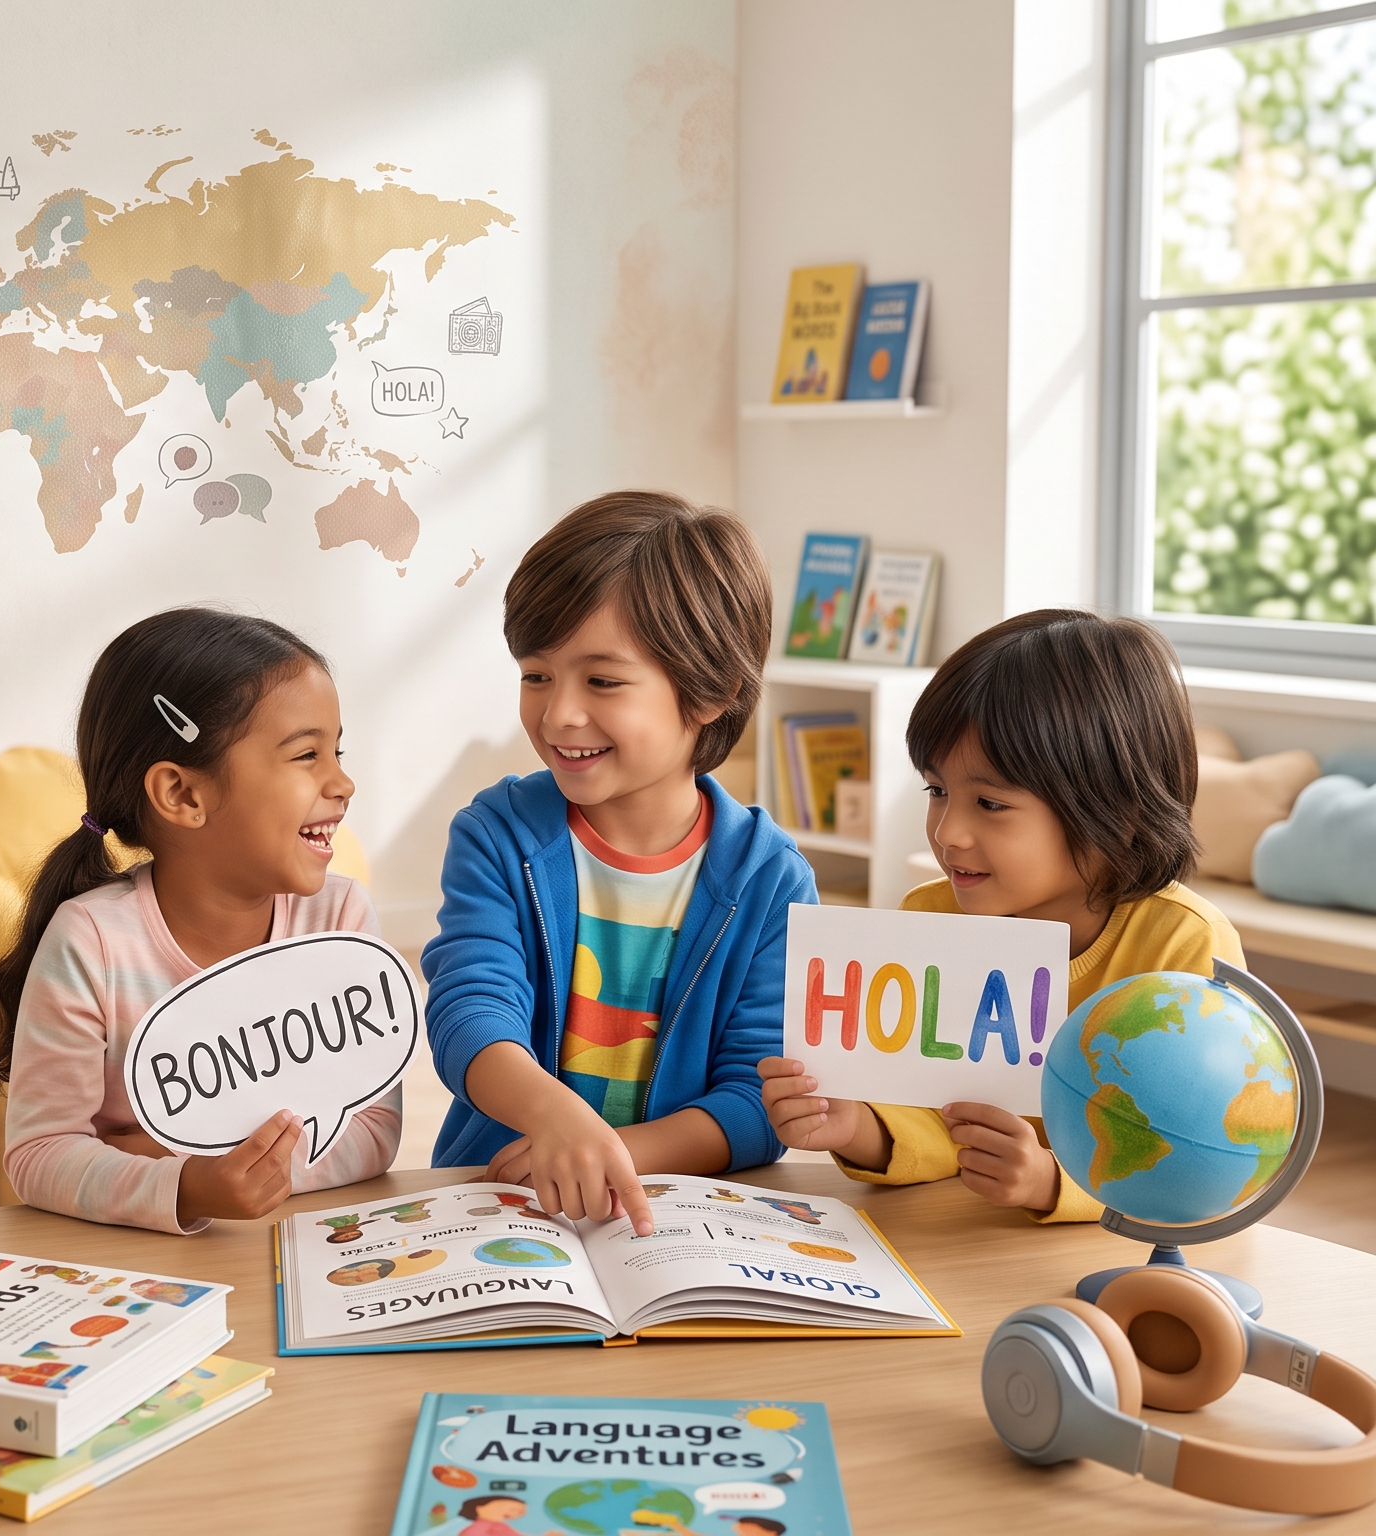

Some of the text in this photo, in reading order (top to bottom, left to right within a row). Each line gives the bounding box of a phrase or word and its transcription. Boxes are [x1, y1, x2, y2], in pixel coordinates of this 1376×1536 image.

[382, 380, 435, 402] HOLA!
[804, 957, 1051, 1066] HOLA!
[150, 970, 400, 1117] BONJOUR!
[346, 1277, 574, 1321] LANGUUAGES
[728, 1263, 881, 1299] GLOBAL
[505, 1414, 743, 1446] Language
[476, 1439, 766, 1469] Adventures
